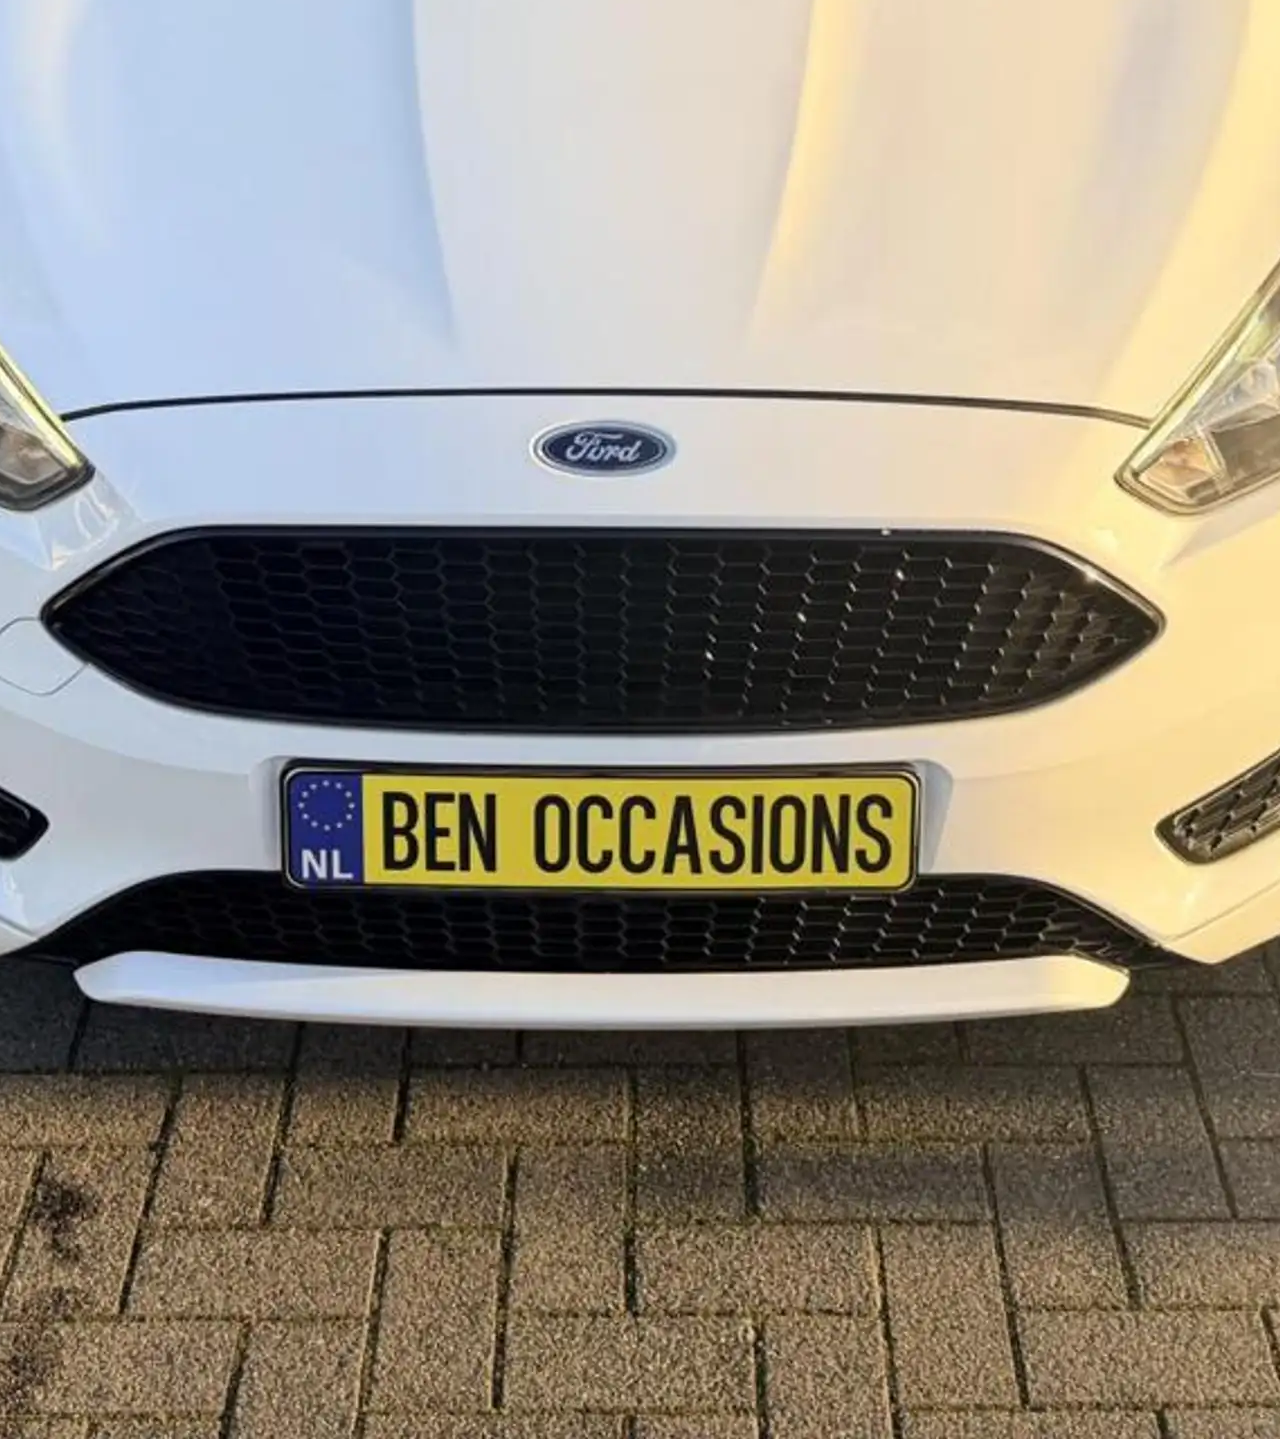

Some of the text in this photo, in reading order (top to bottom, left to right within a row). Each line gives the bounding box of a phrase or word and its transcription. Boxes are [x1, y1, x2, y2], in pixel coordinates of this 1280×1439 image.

[565, 431, 643, 462] Ford
[381, 790, 894, 876] BEN OCCASIONS
[301, 848, 354, 881] NL
